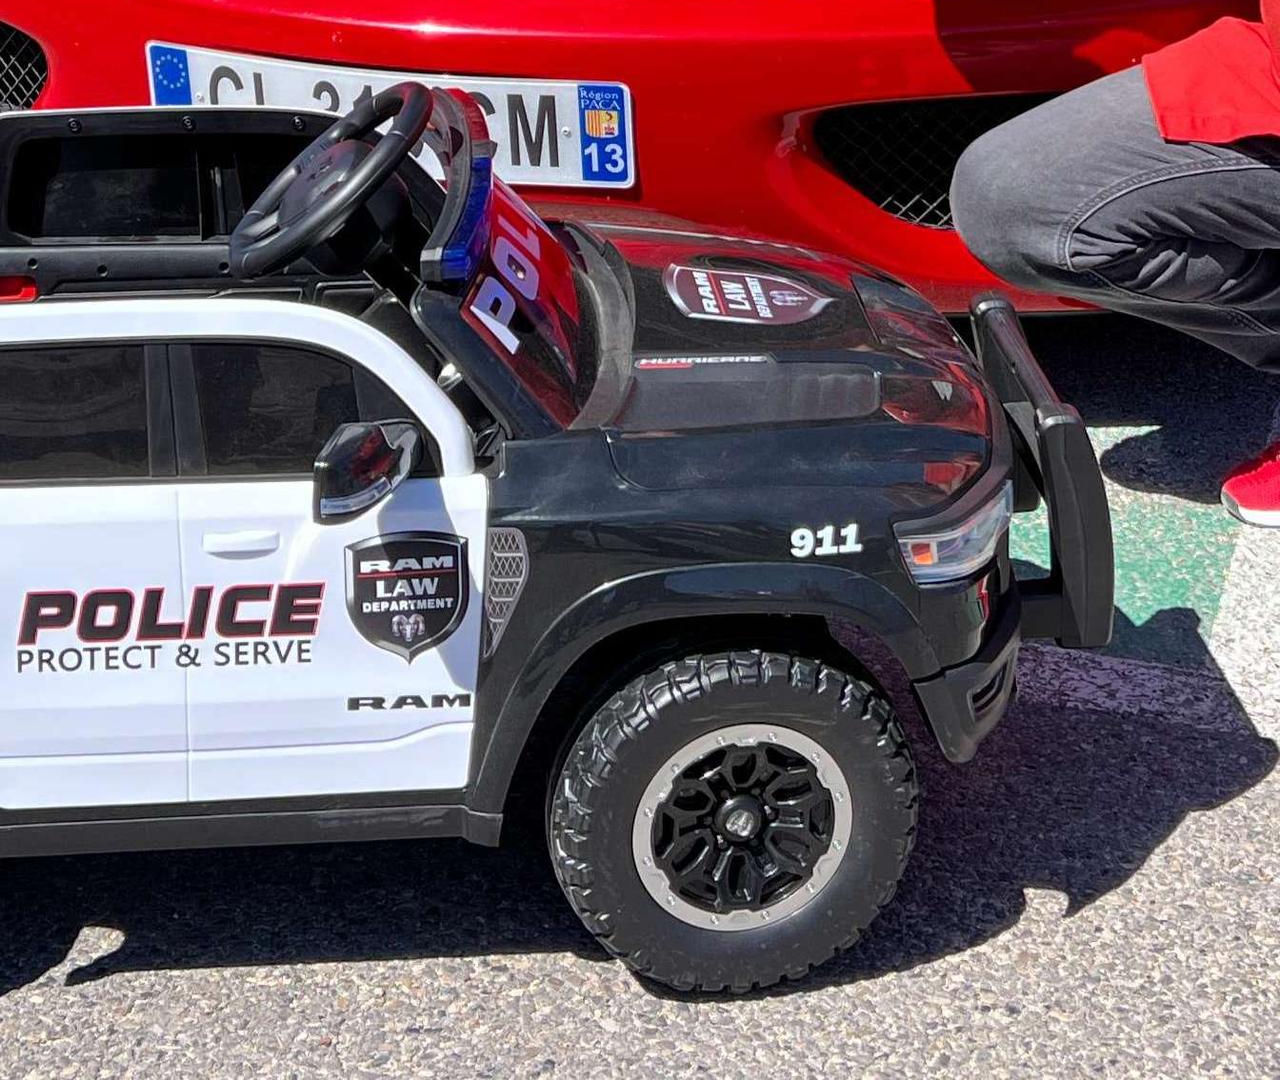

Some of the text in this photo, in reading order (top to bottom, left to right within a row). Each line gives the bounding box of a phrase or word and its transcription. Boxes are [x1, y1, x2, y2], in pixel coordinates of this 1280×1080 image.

[579, 87, 619, 101] Région
[580, 99, 621, 111] PACA
[584, 142, 625, 173] 13
[692, 271, 720, 313] RAM
[720, 280, 752, 311] LAW
[790, 523, 863, 558] 911
[359, 555, 455, 574] RAM
[376, 577, 439, 599] LAW
[17, 582, 326, 647] POLICE
[362, 597, 455, 614] DEPARTMENT
[17, 639, 312, 673] PROTECT & SERVE
[347, 693, 472, 711] RAM
